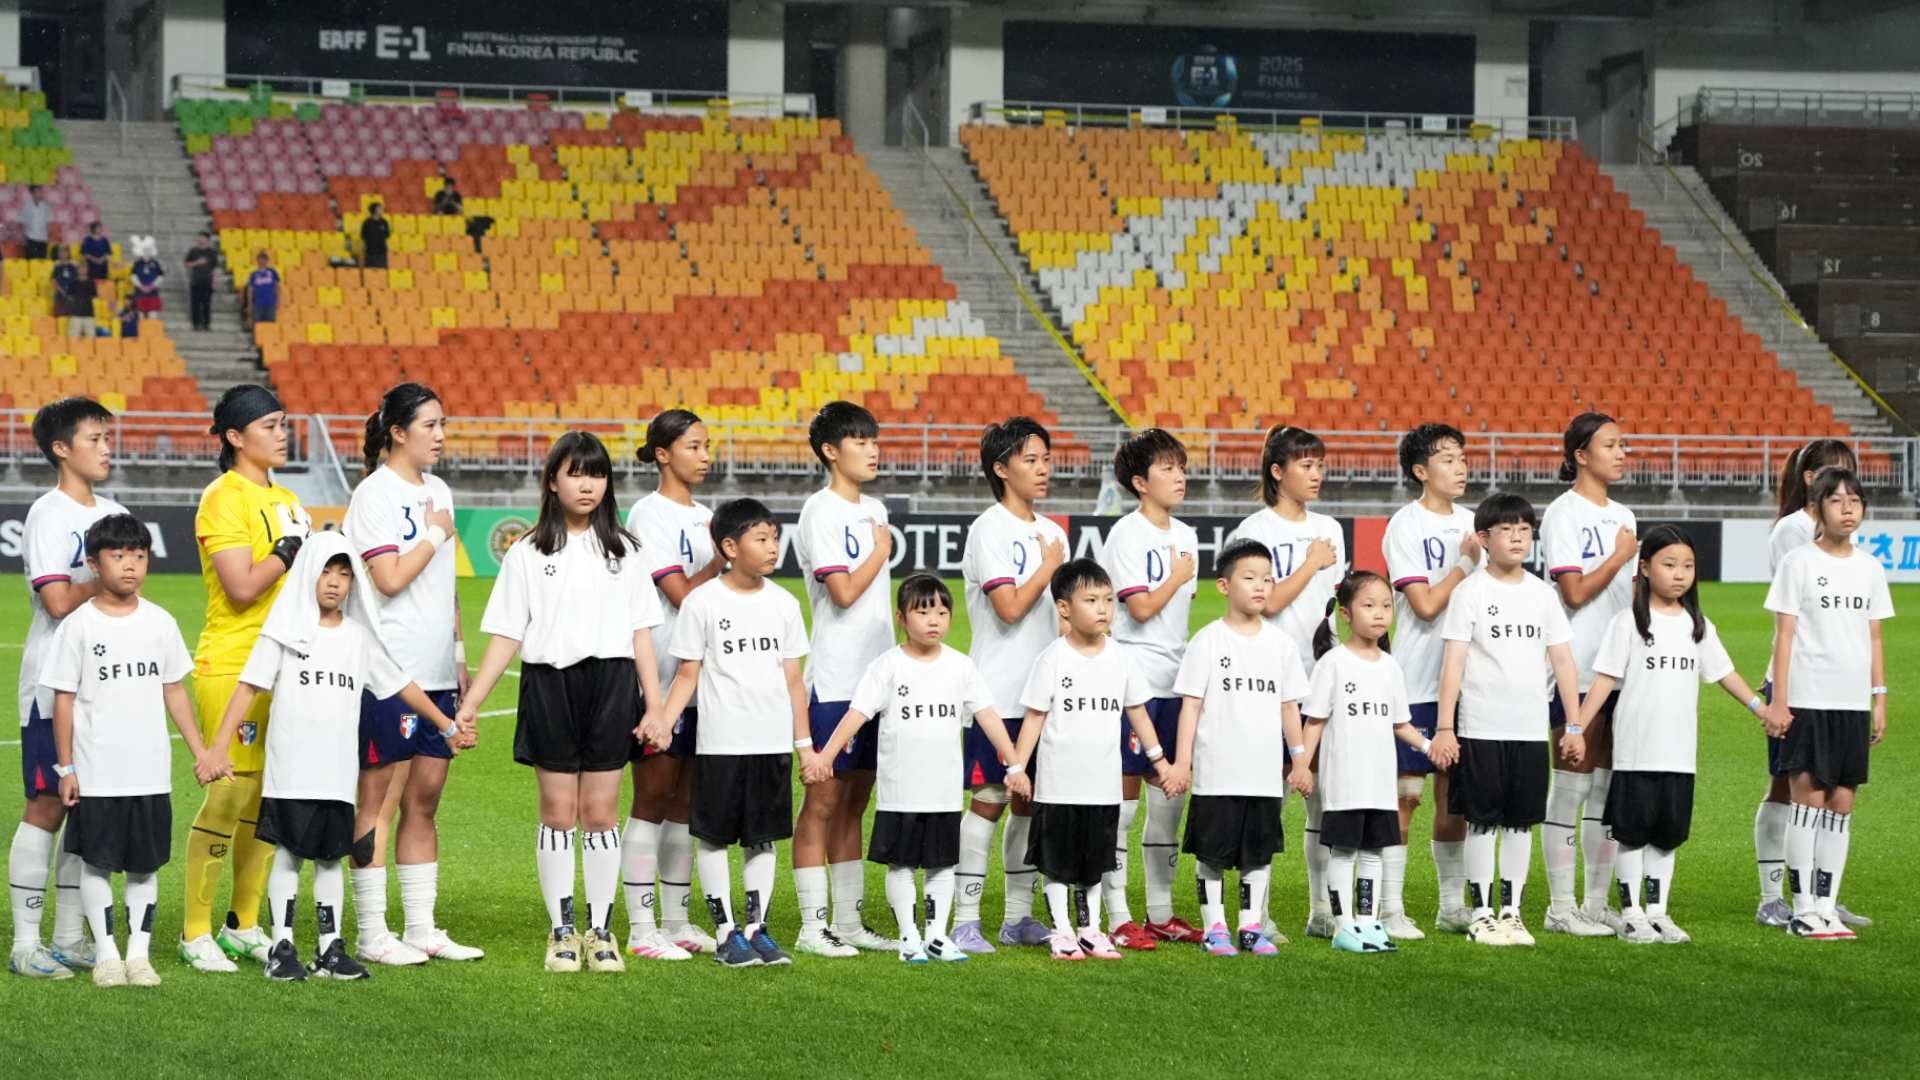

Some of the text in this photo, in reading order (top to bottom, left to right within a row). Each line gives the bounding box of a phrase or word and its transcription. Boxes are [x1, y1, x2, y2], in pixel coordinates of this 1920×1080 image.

[318, 25, 431, 60] EAFF E-1
[447, 42, 639, 63] FINAL KOREA REPUBLIC
[401, 505, 417, 541] 3
[679, 528, 694, 564] 4
[844, 525, 860, 560] 6
[1012, 541, 1027, 576] 9
[1423, 536, 1445, 571] 19
[1581, 526, 1604, 559] 21
[1271, 543, 1294, 579] 17
[98, 661, 160, 681] SFIDA
[299, 670, 355, 691] SFIDA
[1222, 677, 1276, 694] SFIDA
[901, 703, 956, 721] SFIDA
[1063, 697, 1120, 713] SFIDA
